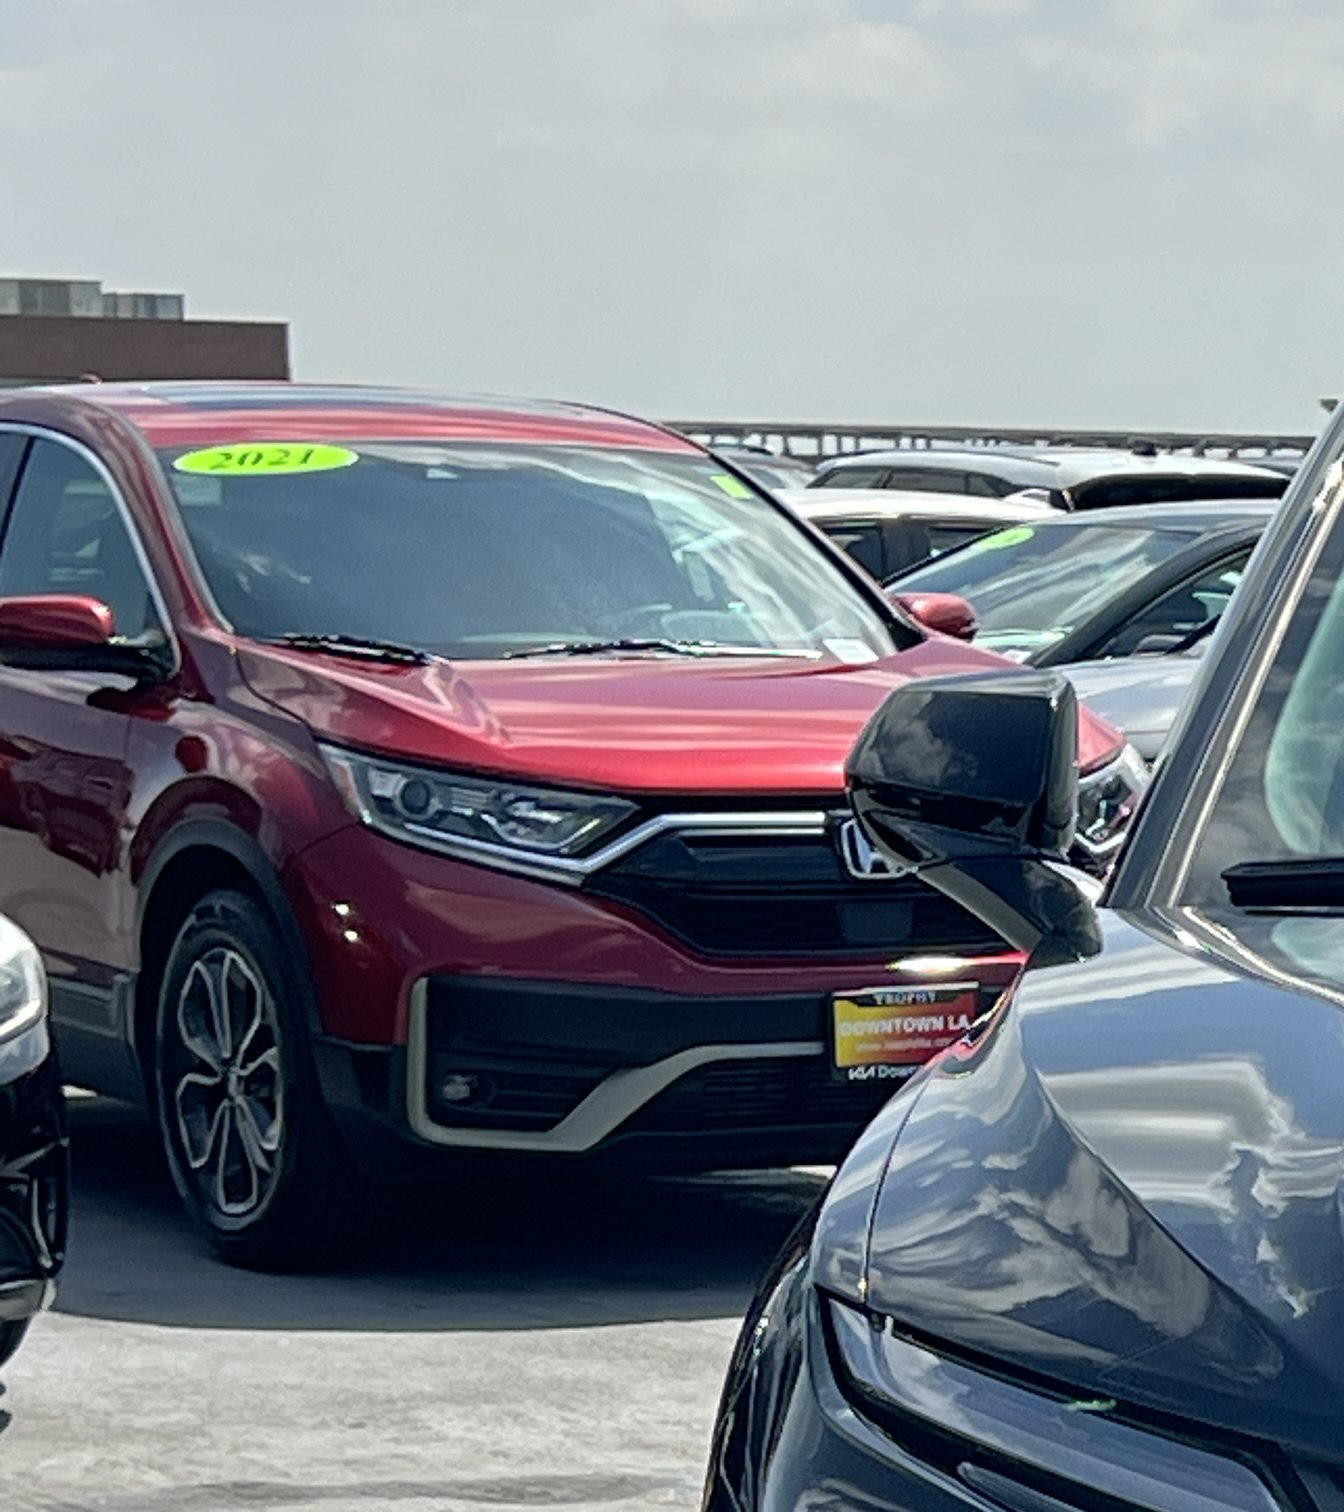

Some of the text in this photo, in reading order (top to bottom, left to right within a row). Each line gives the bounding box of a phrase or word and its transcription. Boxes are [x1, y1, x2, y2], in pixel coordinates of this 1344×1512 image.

[209, 449, 314, 470] 2021
[840, 1014, 970, 1036] DOWNTOWN LA
